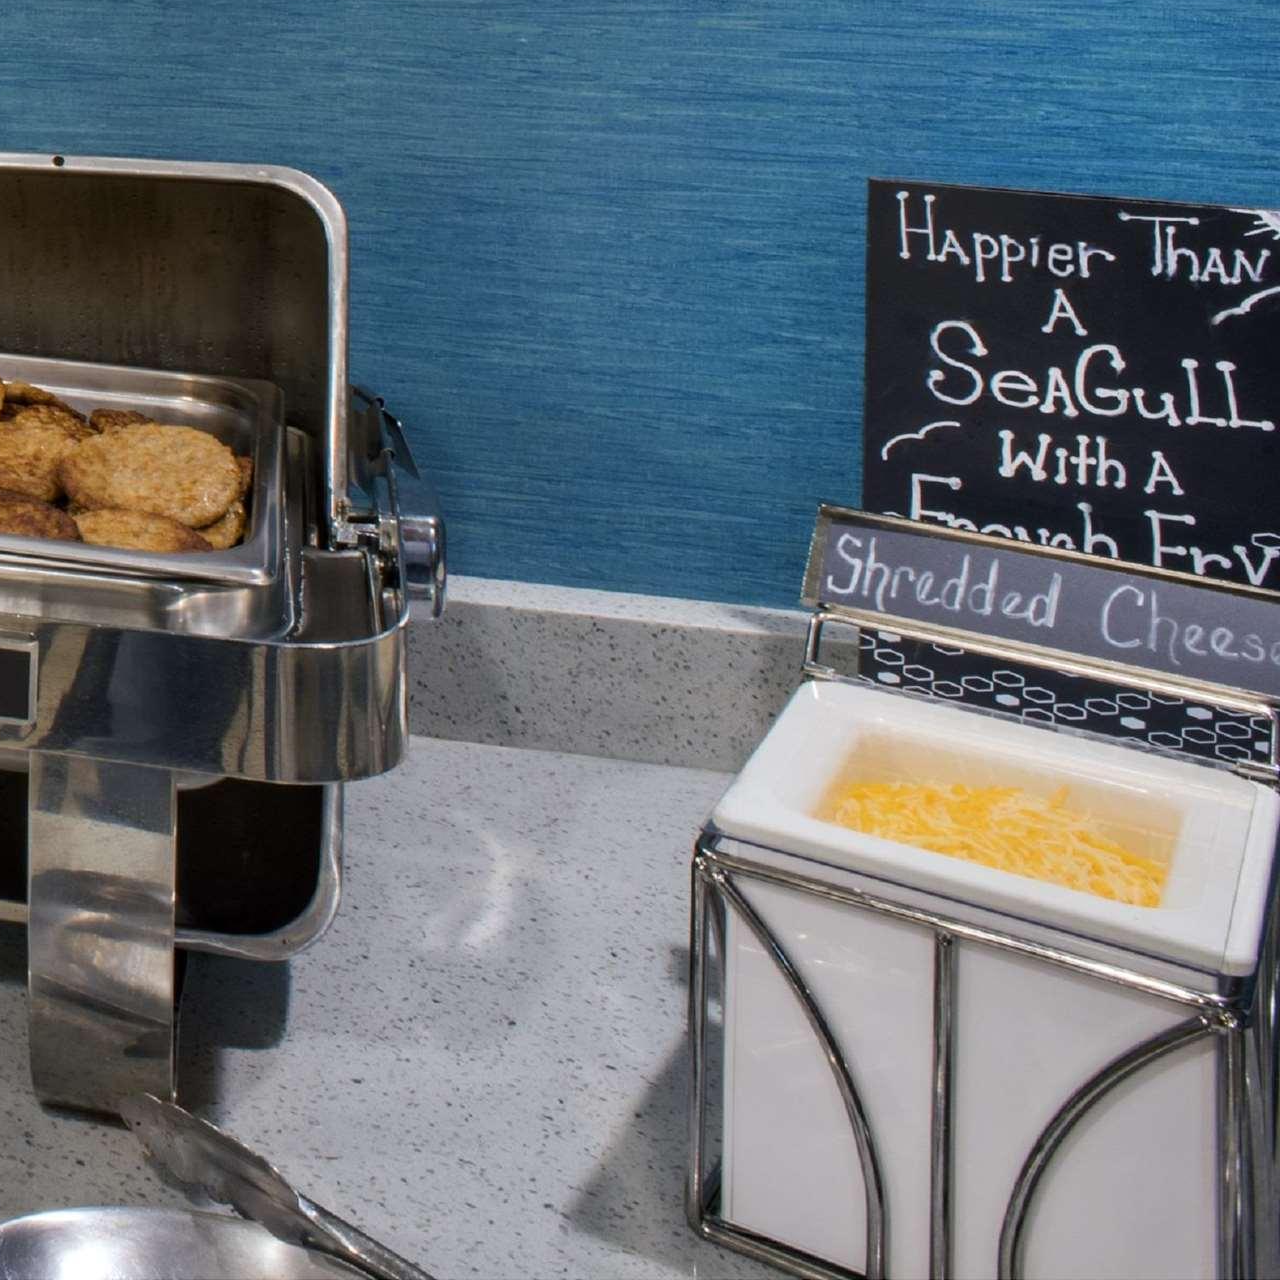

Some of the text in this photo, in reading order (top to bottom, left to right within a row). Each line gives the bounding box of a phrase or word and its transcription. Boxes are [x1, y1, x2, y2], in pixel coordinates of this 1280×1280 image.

[1041, 287, 1089, 336] A
[1143, 450, 1185, 496] A
[826, 532, 1063, 629] Shredded
